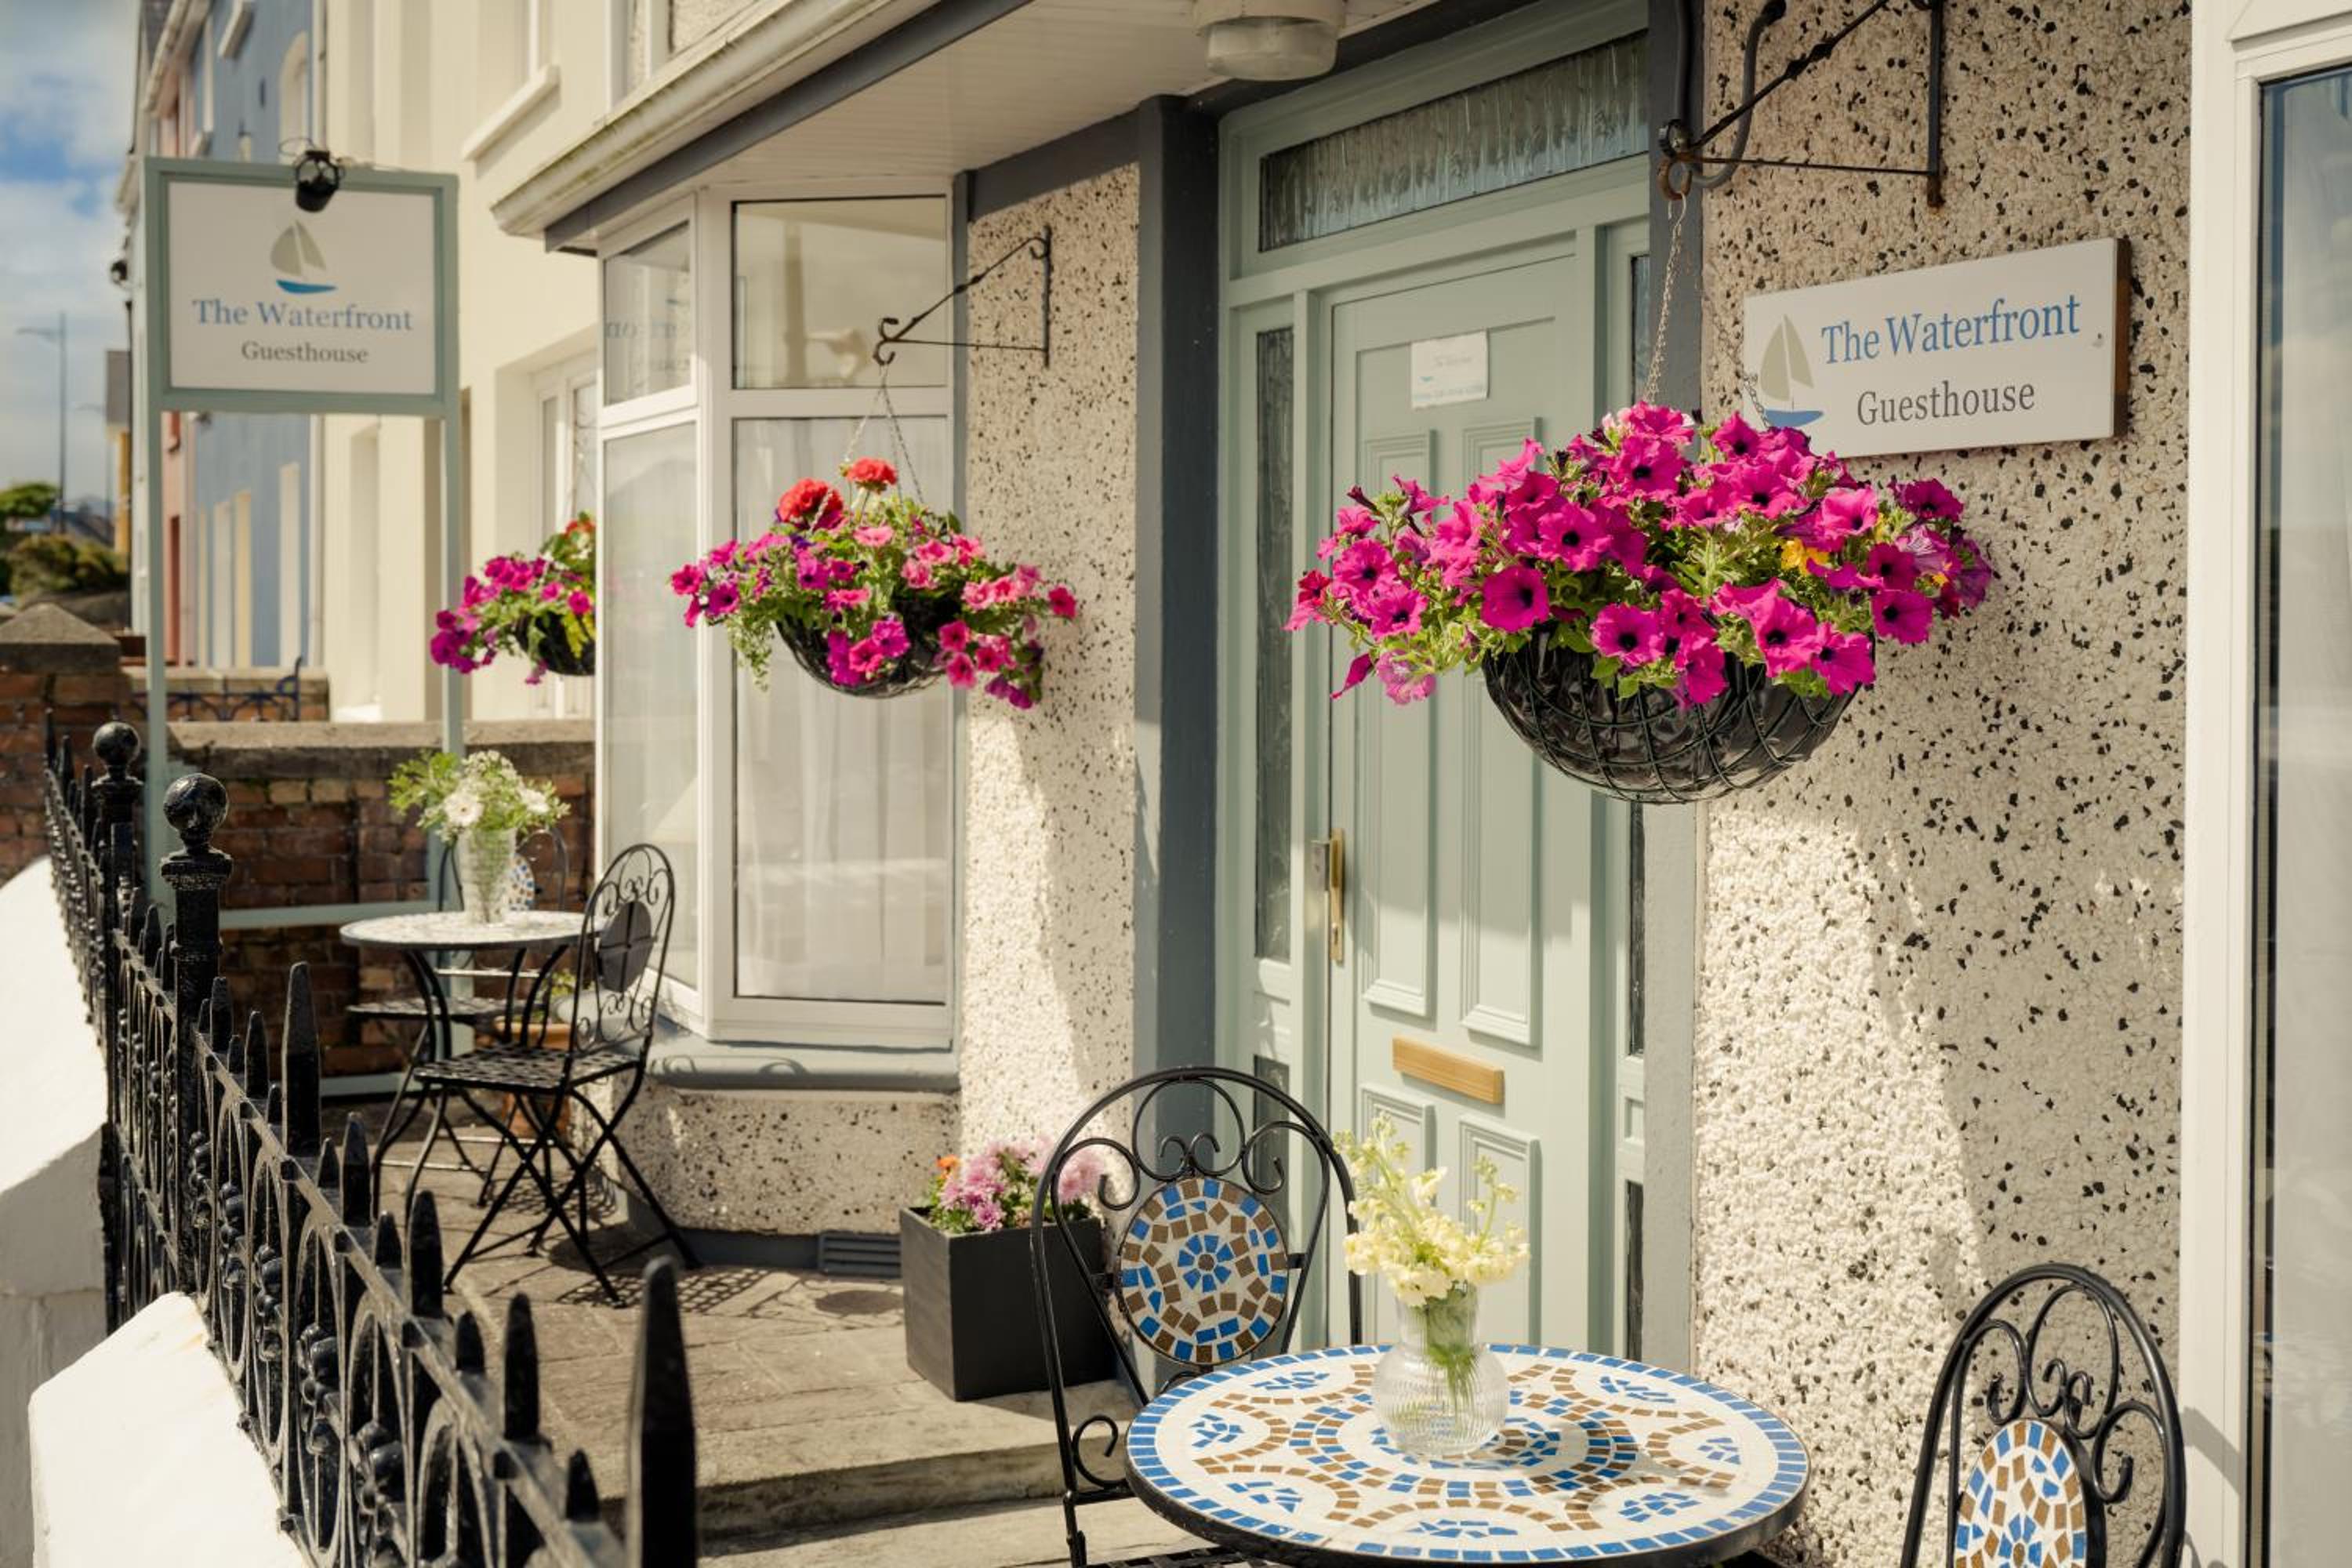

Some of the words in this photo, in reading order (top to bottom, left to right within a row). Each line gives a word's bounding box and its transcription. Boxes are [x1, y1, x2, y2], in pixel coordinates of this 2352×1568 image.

[192, 298, 249, 326] The
[256, 300, 413, 331] Waterfront
[1820, 321, 1880, 365] The
[1886, 294, 2082, 355] Waterfront
[241, 340, 369, 364] Guesthouse
[1857, 379, 2036, 426] Guesthouse
